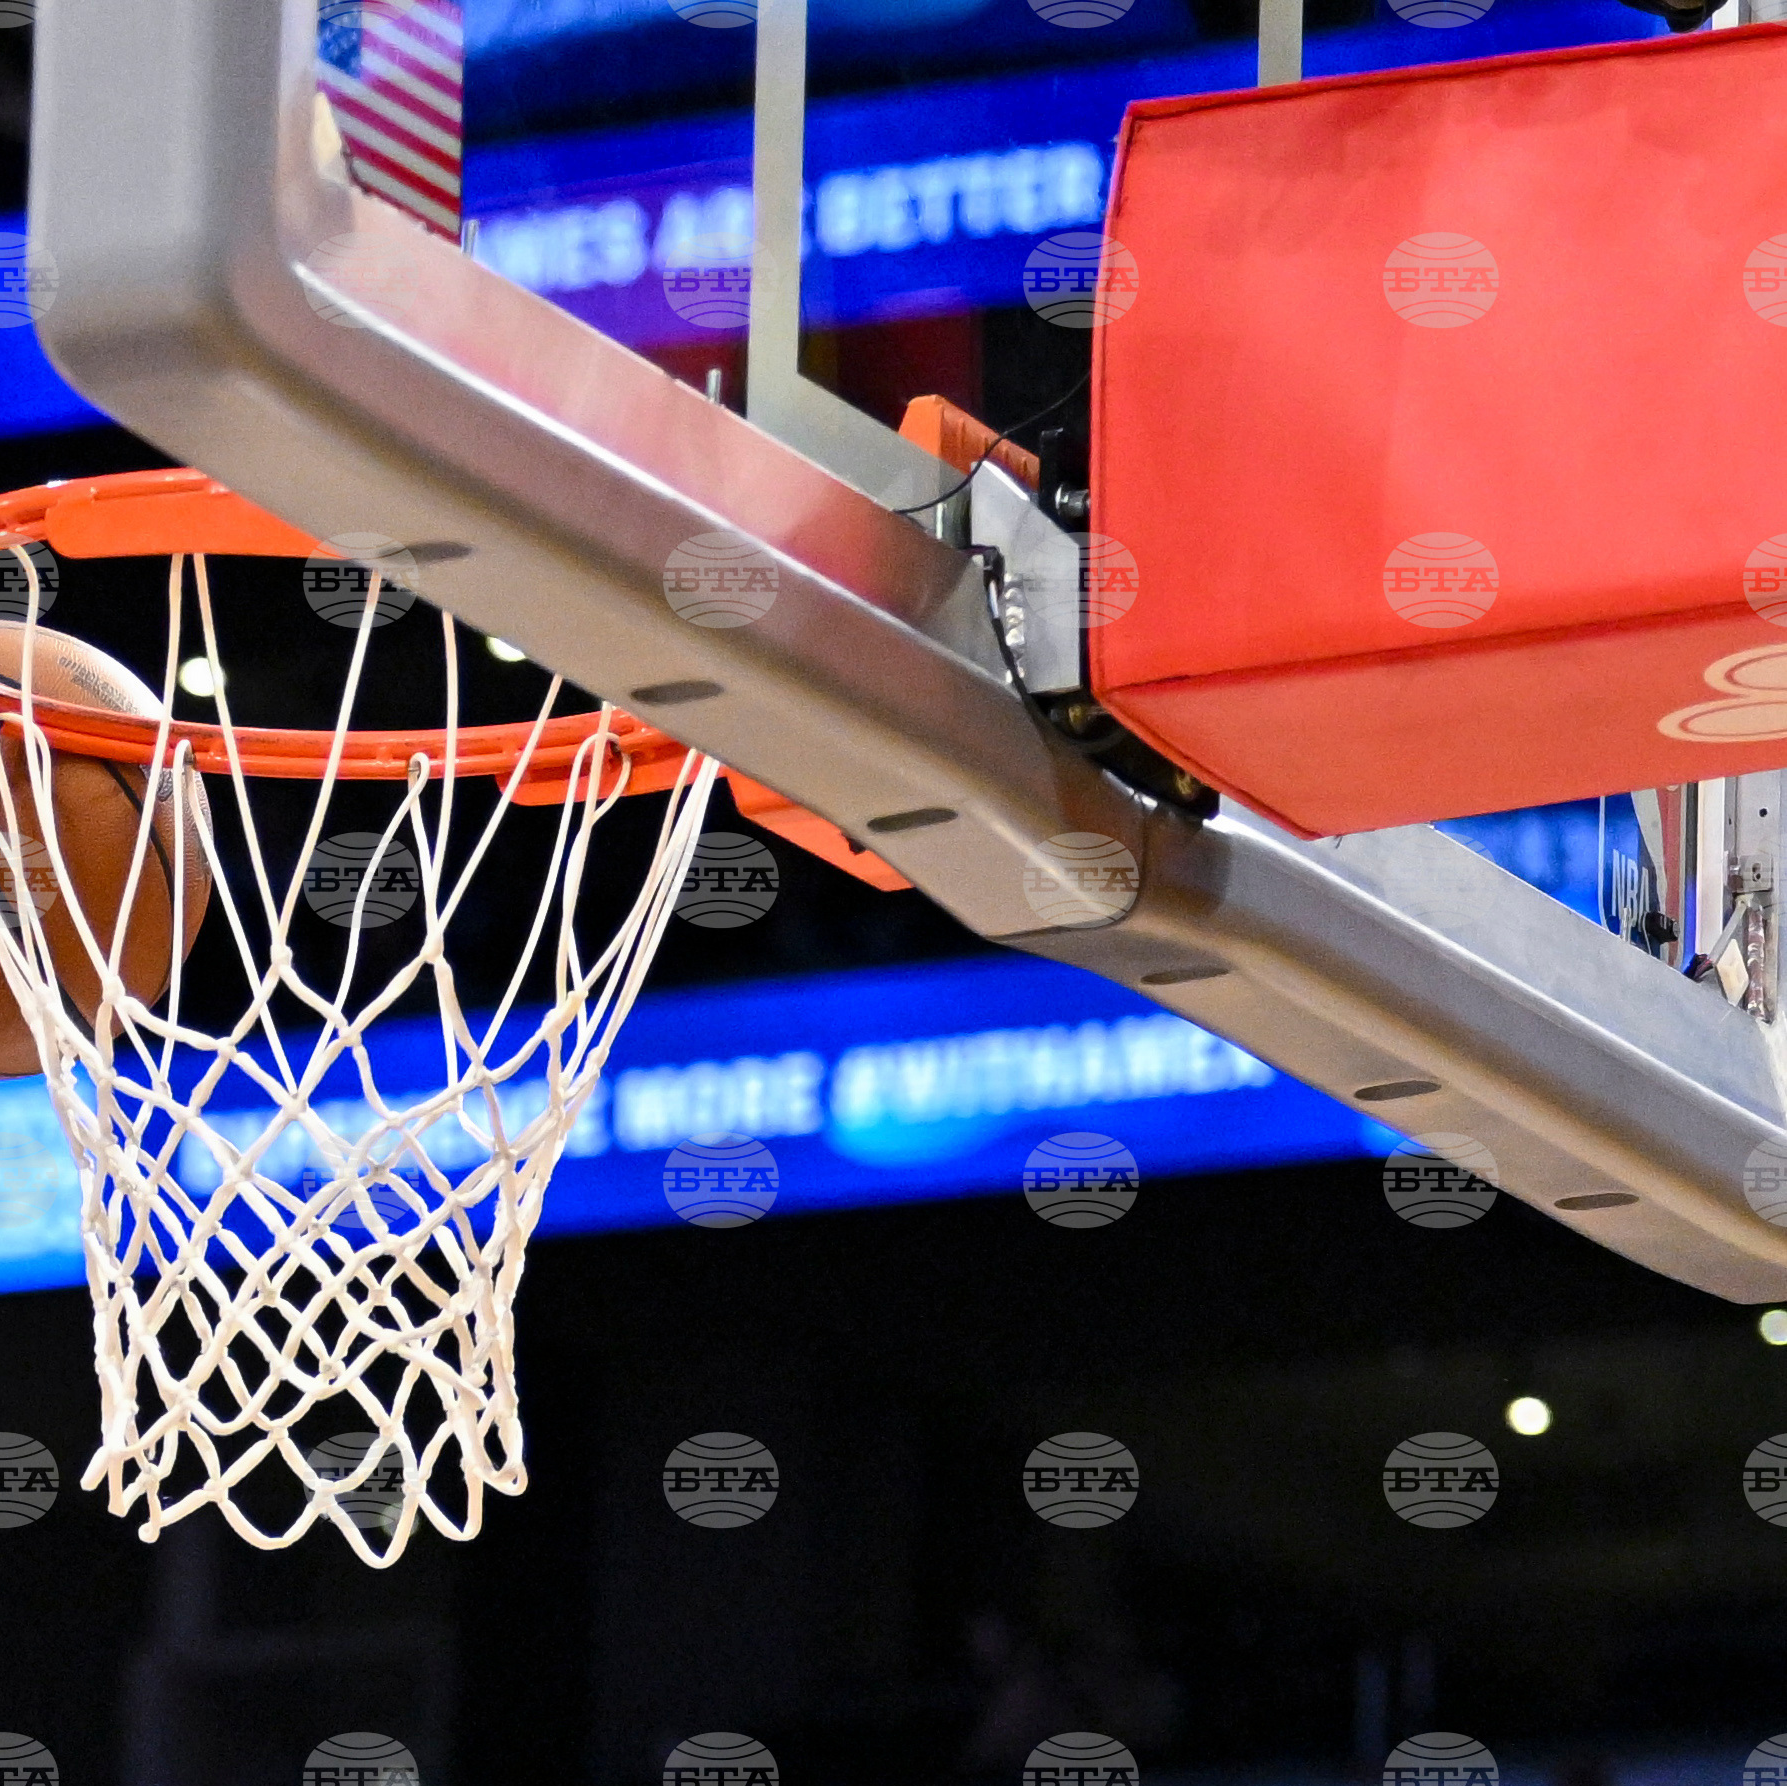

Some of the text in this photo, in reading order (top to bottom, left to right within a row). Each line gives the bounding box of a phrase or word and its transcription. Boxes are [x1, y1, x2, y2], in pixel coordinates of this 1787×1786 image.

[816, 141, 1105, 257] BETTER
[1611, 848, 1650, 928] NBA
[614, 1049, 824, 1151] MORE
